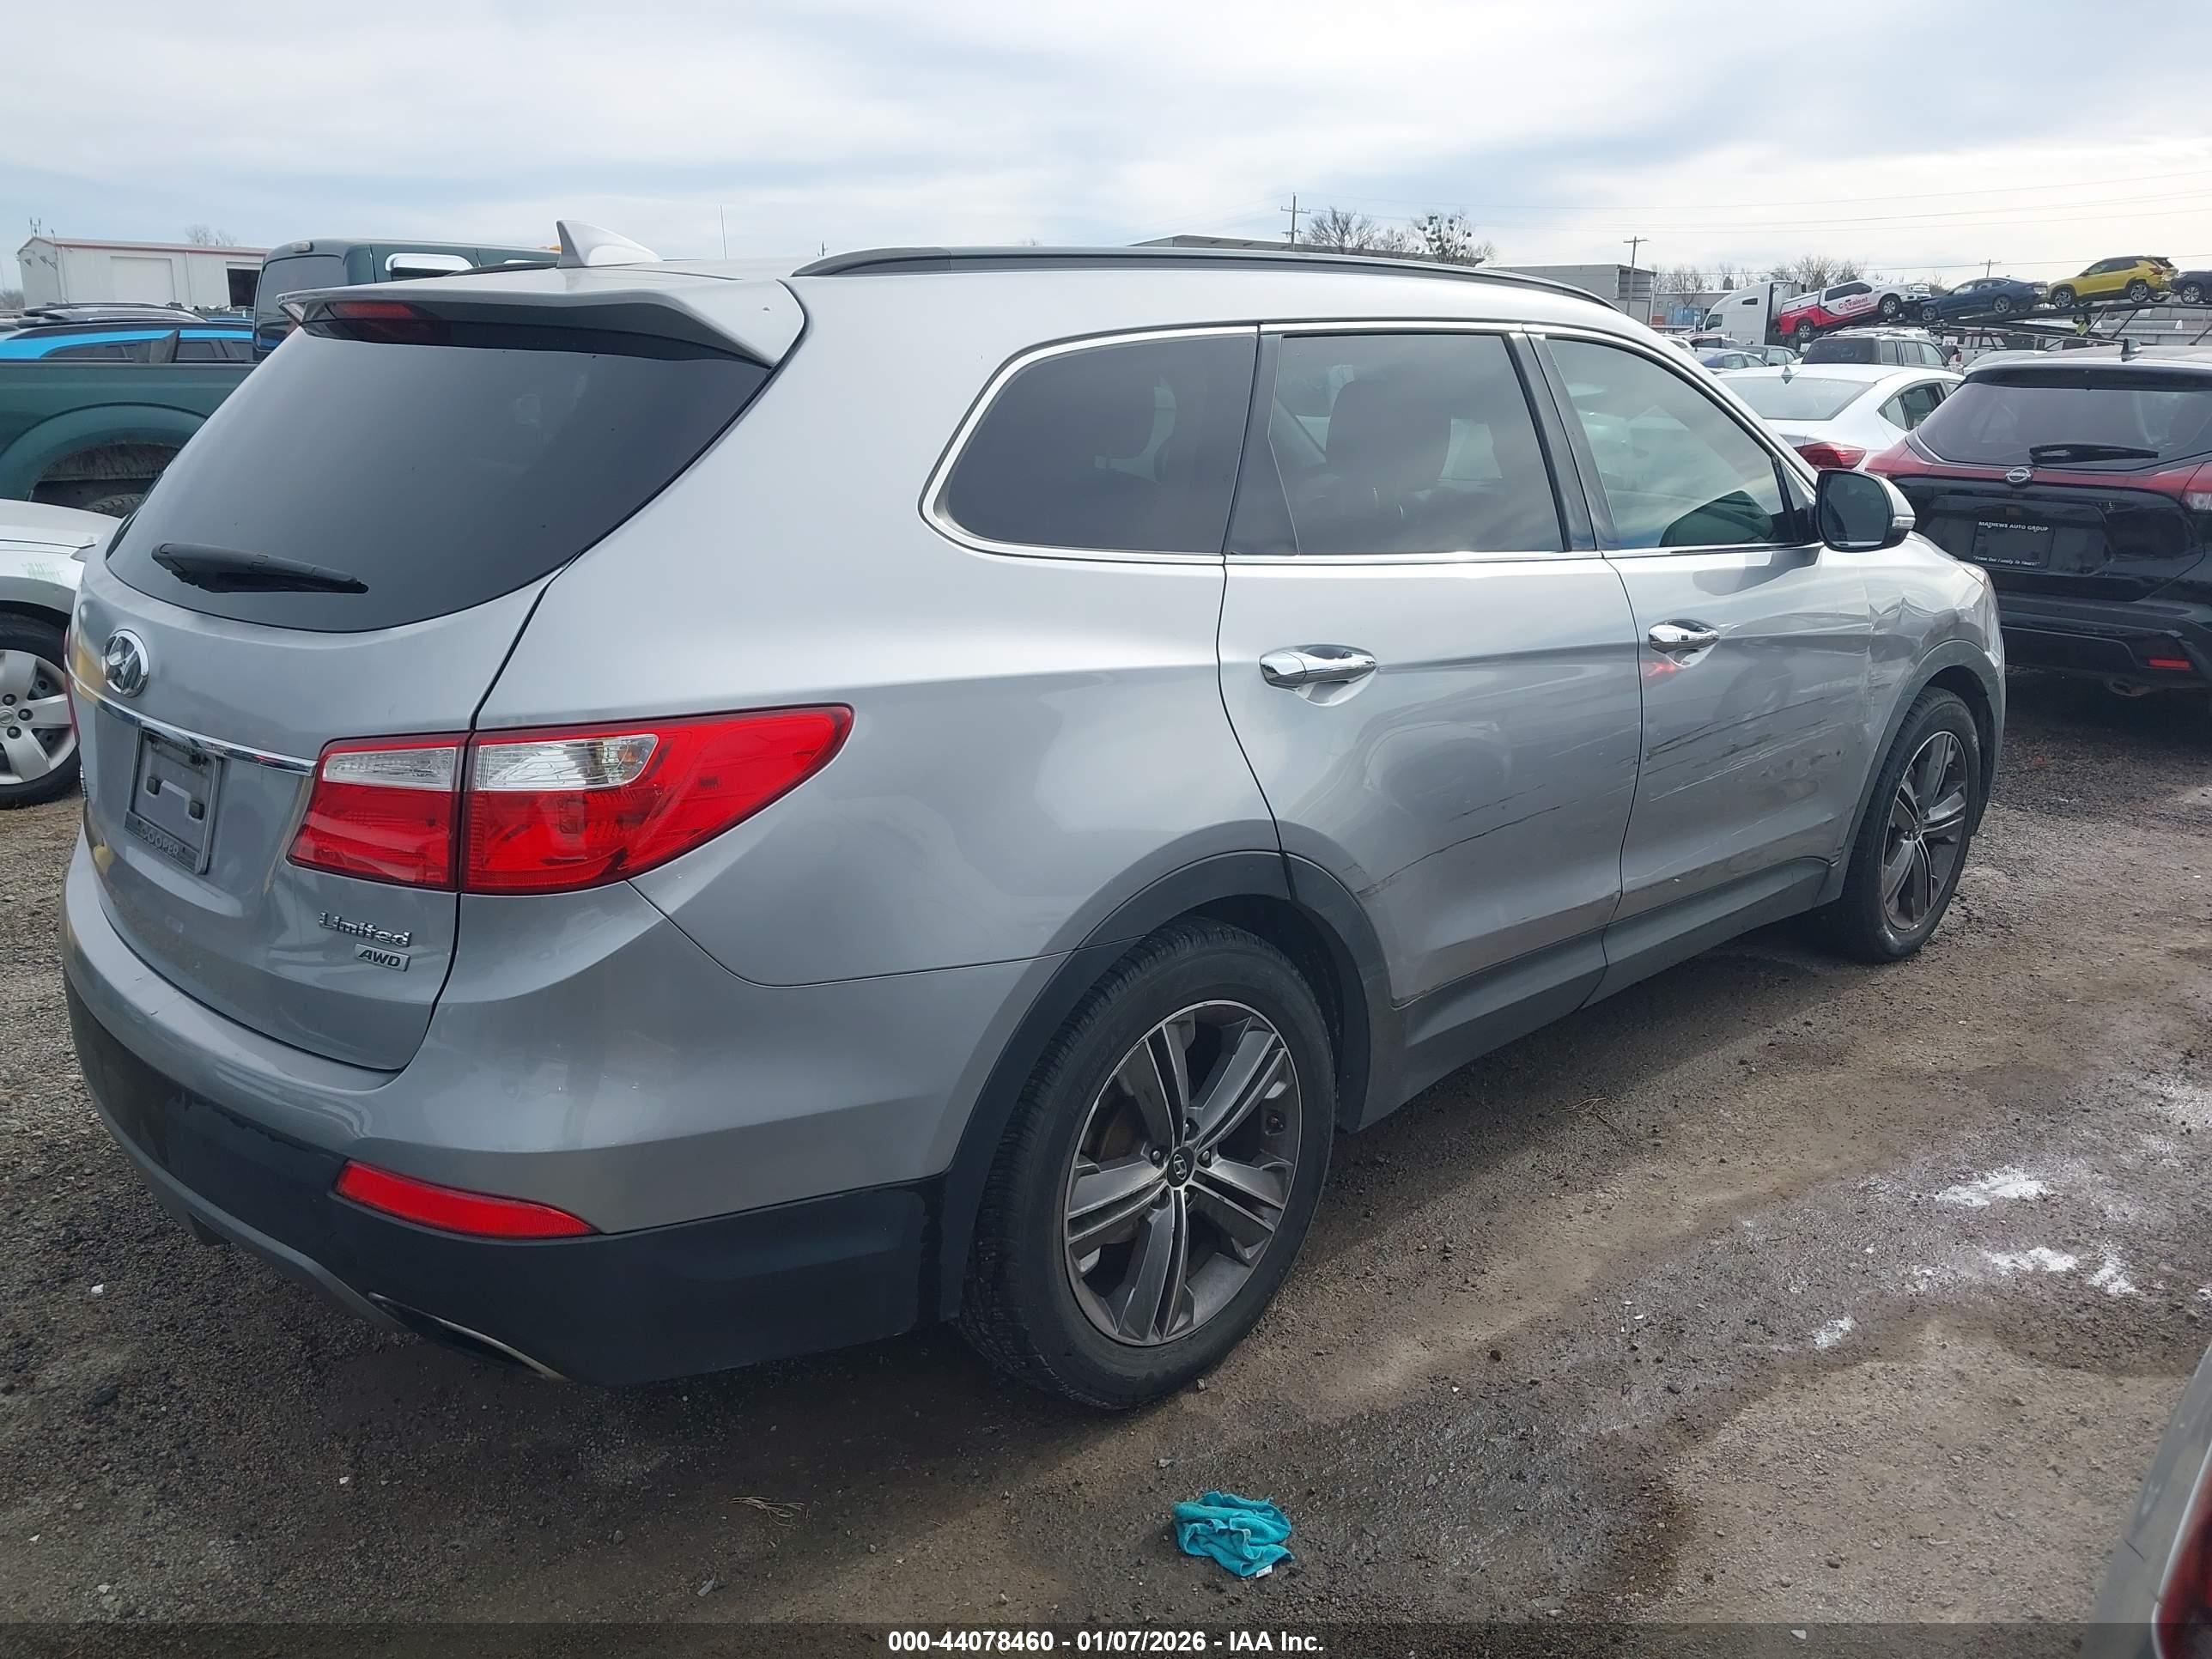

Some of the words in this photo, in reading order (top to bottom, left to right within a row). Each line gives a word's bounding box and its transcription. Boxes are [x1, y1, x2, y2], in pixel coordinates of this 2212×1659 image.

[1838, 296, 1869, 309] Covalent
[319, 911, 412, 947] Limited
[358, 949, 401, 967] AWD
